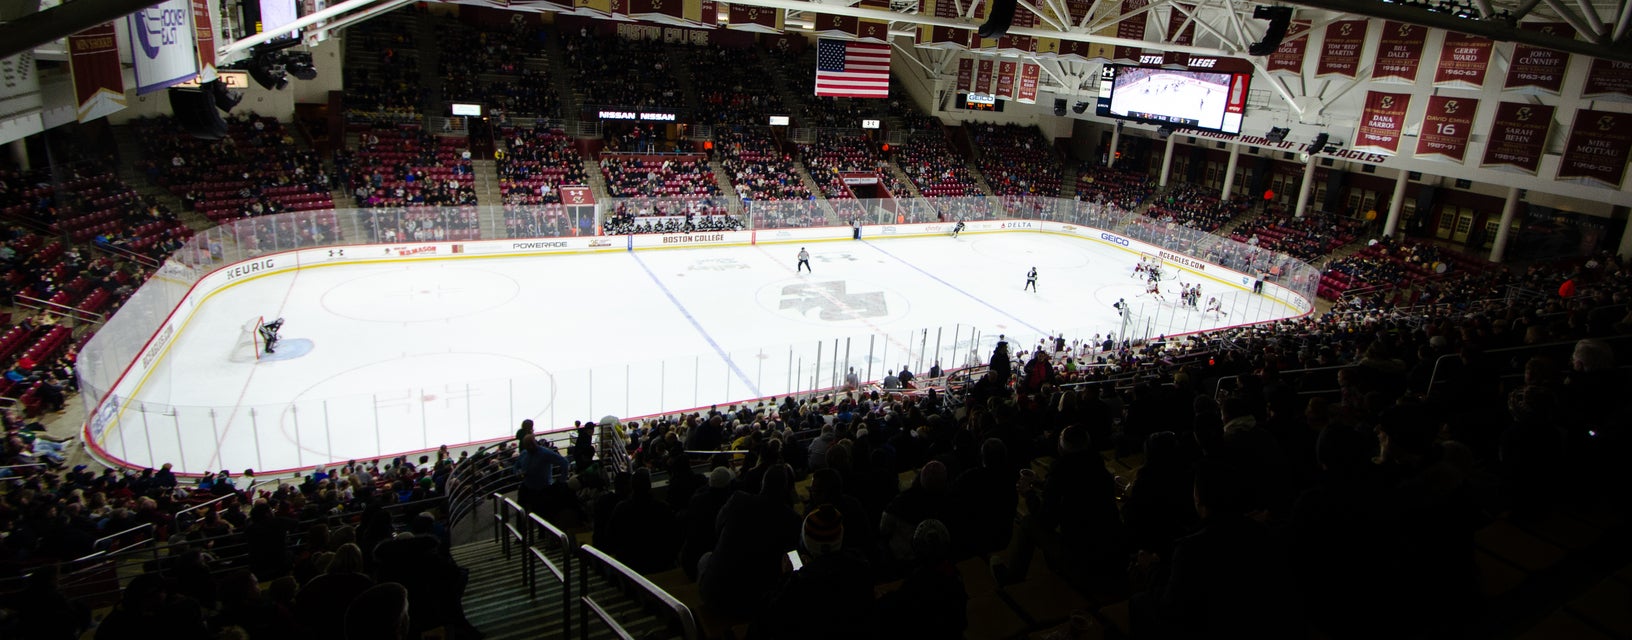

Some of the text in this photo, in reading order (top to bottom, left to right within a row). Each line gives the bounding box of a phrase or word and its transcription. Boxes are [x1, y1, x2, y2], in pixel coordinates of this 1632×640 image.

[161, 9, 187, 26] HOCKEY
[161, 27, 178, 45] EAST
[617, 23, 709, 44] BOSTON COLLEGE
[1529, 50, 1552, 58] JOHN
[1518, 57, 1561, 66] CUNNIFF
[1516, 73, 1553, 81] 1963-66
[968, 94, 994, 102] GEICO
[598, 111, 676, 121] NISSAN NISSAN
[1372, 114, 1393, 122] DANA
[1368, 120, 1395, 129] BARROS
[1436, 123, 1456, 135] 16
[1504, 127, 1534, 136] SARAH
[1504, 134, 1530, 143] BEHN
[1426, 142, 1457, 150] 1987-91
[1587, 139, 1612, 148] MIKE
[1575, 145, 1617, 156] MOTTAU
[1328, 148, 1390, 163] AGLES
[1494, 153, 1529, 163] 1989-93
[1007, 221, 1033, 230] DELTA
[663, 233, 725, 244] BOSTON COLLEGE
[1101, 232, 1131, 248] GEICO
[512, 241, 569, 250] POWERADE
[1158, 250, 1206, 272] BCEAGLES.COM
[226, 258, 275, 281] KEURIG
